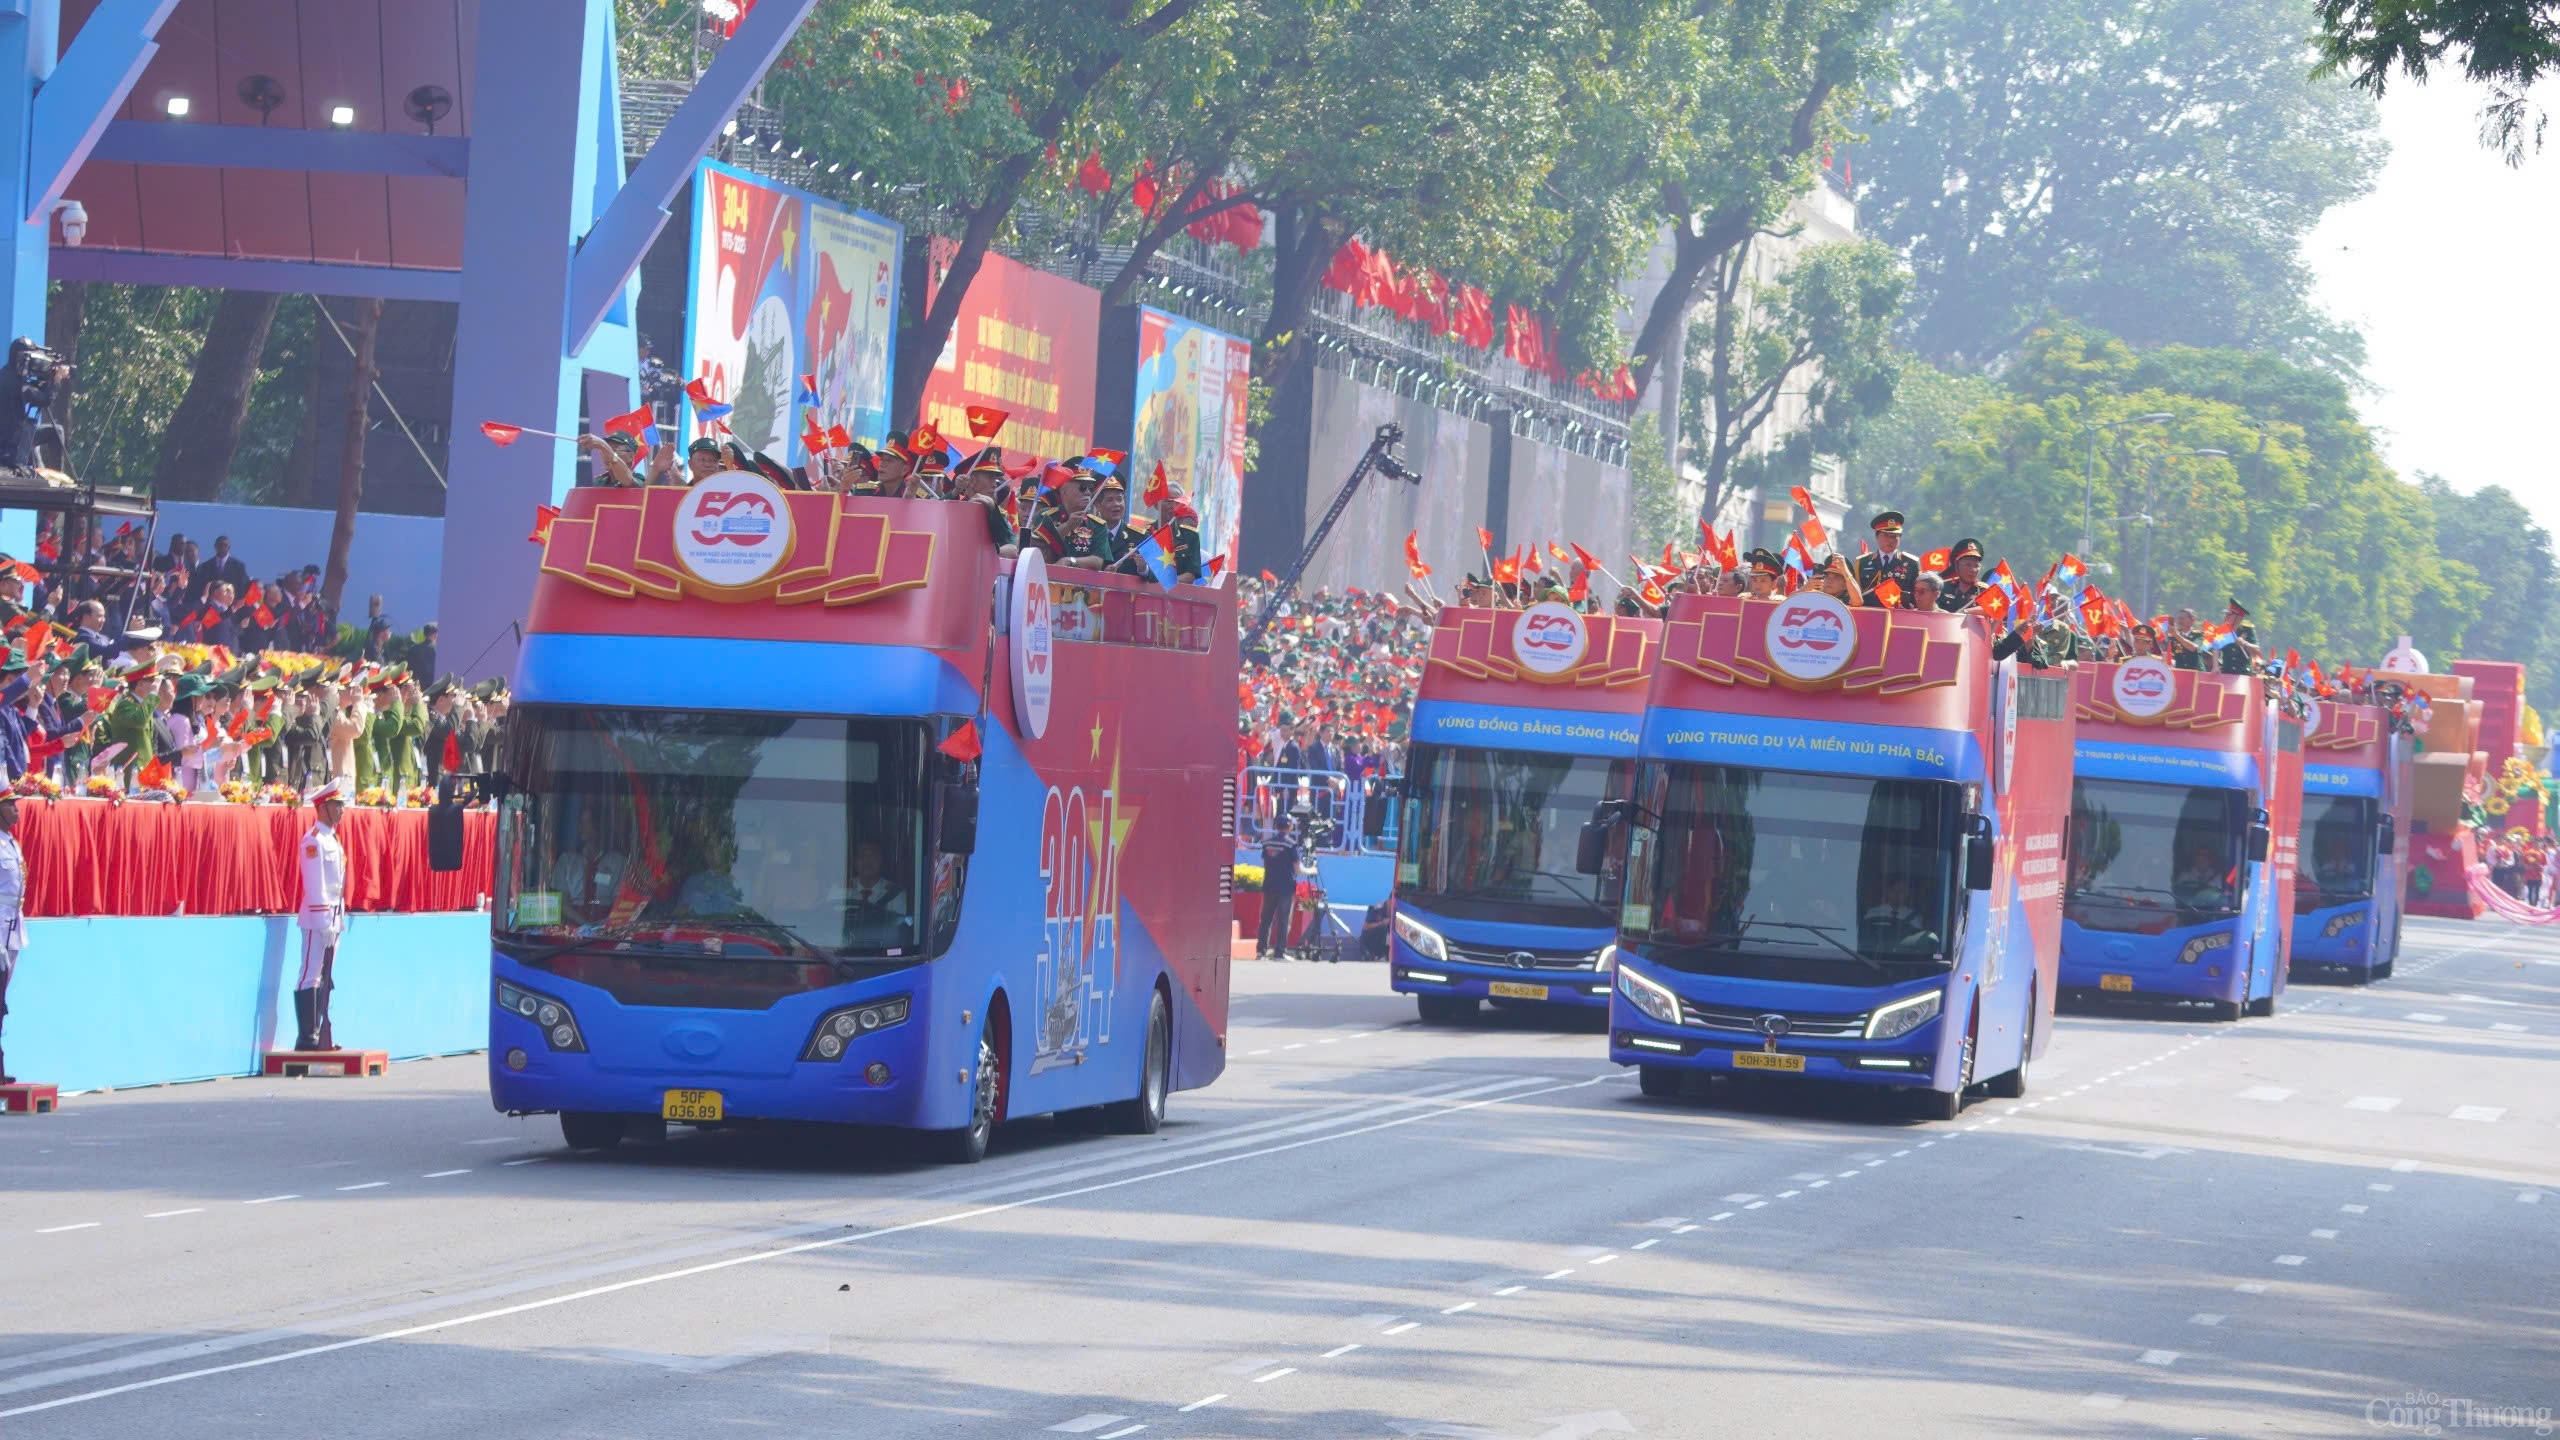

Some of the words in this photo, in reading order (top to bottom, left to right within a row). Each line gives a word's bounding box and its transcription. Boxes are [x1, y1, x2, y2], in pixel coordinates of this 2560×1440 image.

[691, 492, 775, 546] 50
[1778, 607, 1843, 651] 50
[1438, 716, 1474, 729] VÙNG
[1566, 724, 1604, 740] SÔNG
[1609, 727, 1639, 745] HỒN
[1666, 730, 1704, 744] VÙNG
[1709, 731, 1758, 746] TRUNG
[1763, 735, 1783, 747] DU
[1787, 733, 1805, 749] VÀ
[1810, 734, 1845, 752] MIỀN
[1850, 738, 1874, 754] NÚI
[1878, 742, 1912, 758] PHÍA
[1916, 747, 1945, 767] BẮC
[669, 1105, 716, 1119] 036.89
[681, 1091, 705, 1104] 50F
